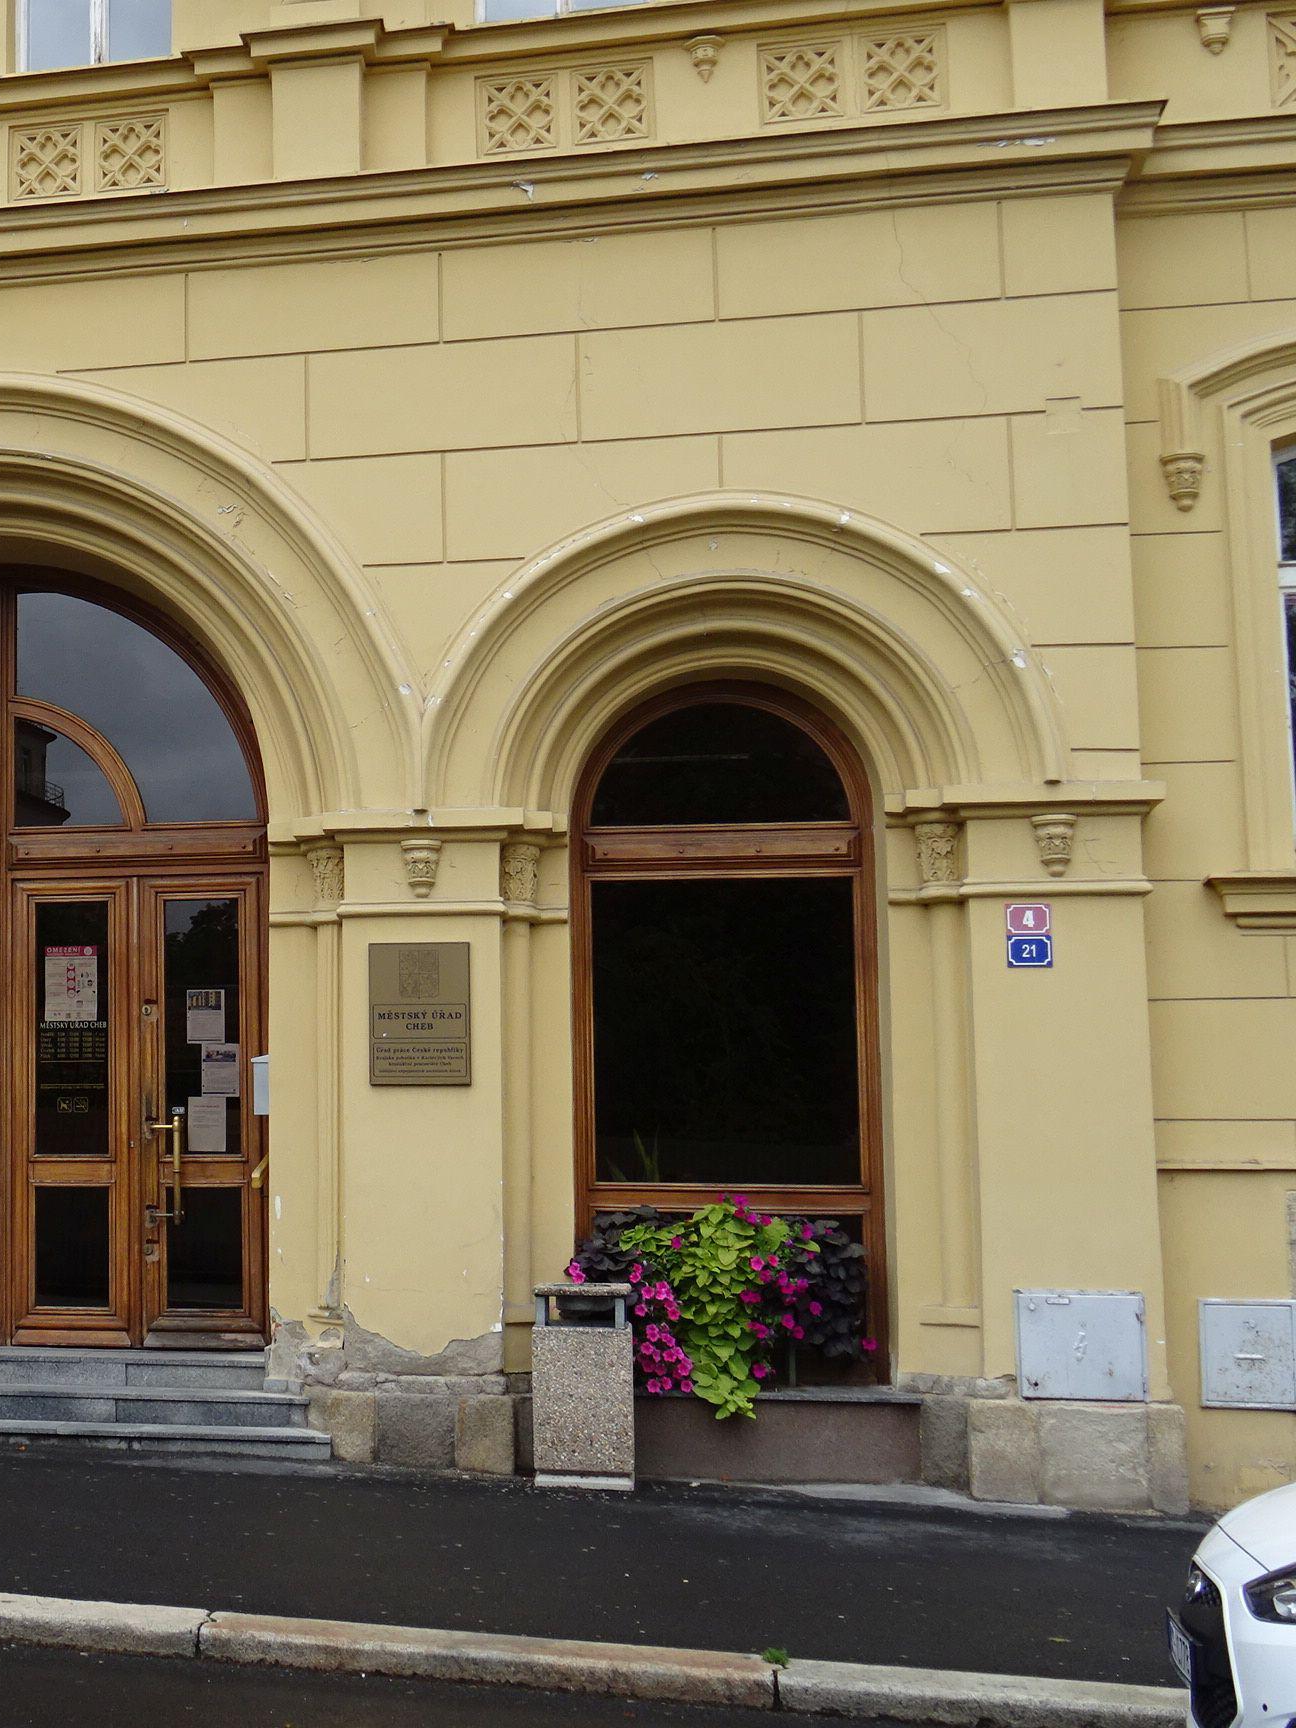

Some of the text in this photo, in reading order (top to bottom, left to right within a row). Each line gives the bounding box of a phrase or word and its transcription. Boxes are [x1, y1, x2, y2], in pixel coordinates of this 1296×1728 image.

[1023, 911, 1035, 927] 4
[1022, 944, 1036, 957] 21
[377, 1009, 462, 1020] MĚSTSKÝ ÚŘAD
[89, 1021, 107, 1029] CHEB
[405, 1022, 434, 1031] CHEB
